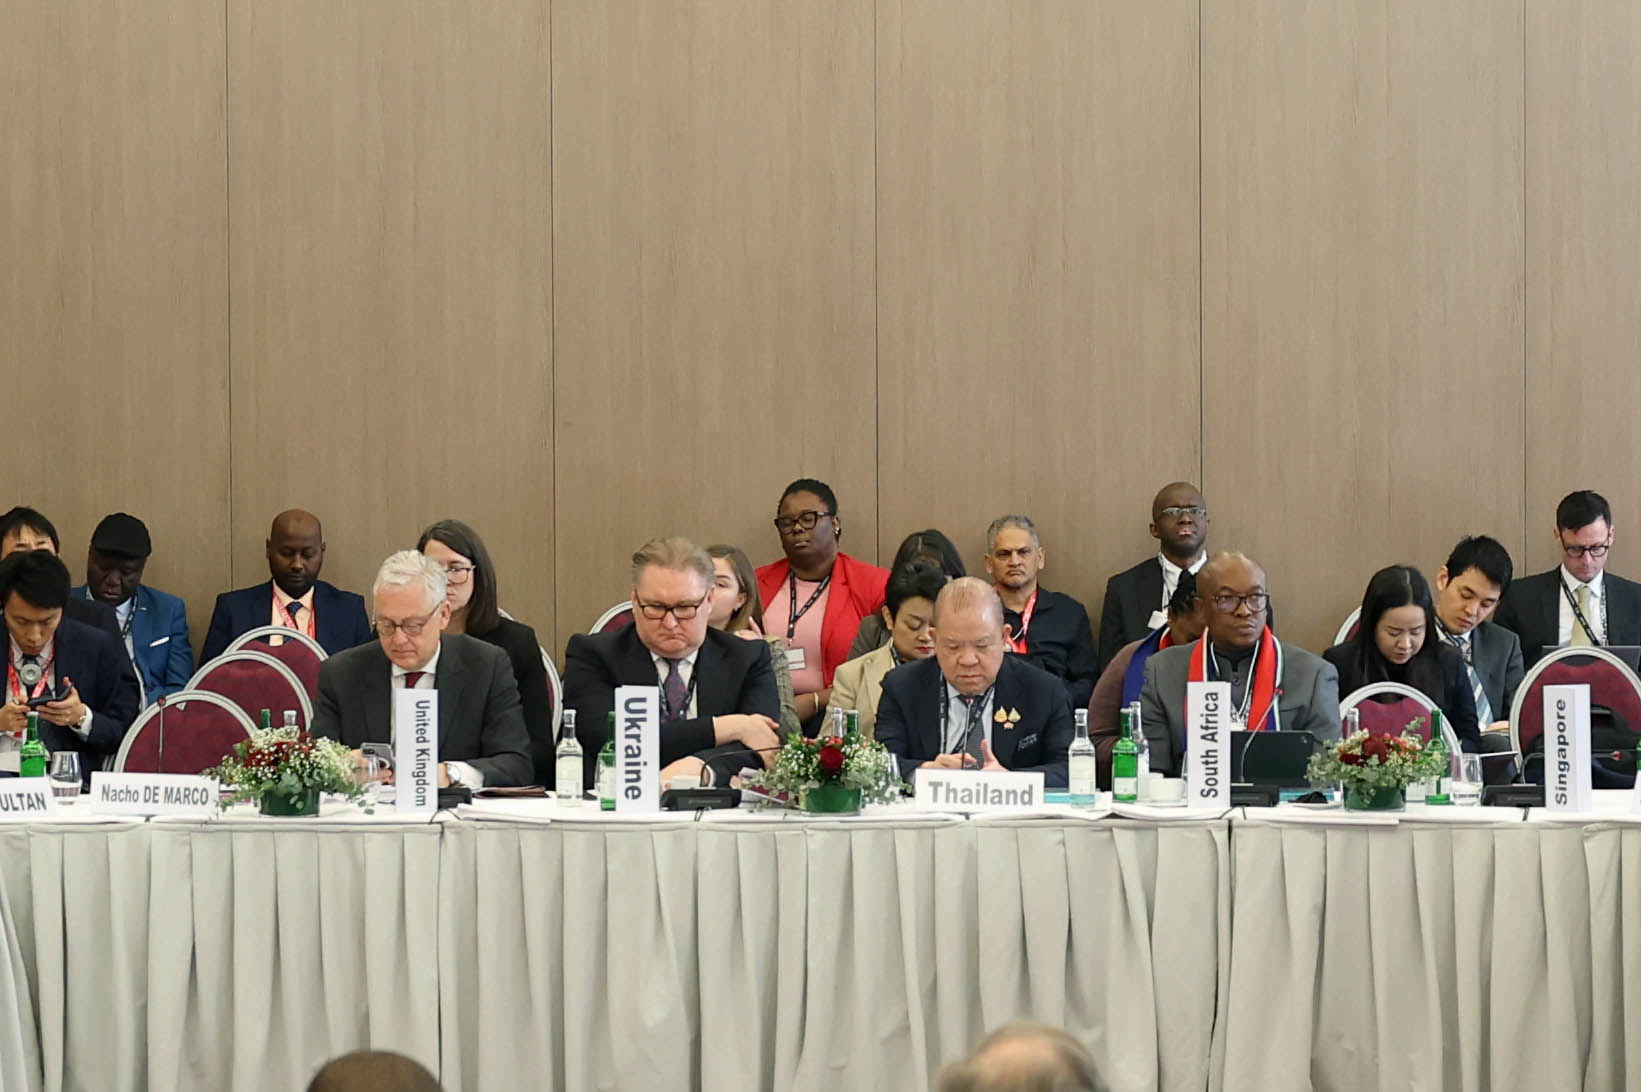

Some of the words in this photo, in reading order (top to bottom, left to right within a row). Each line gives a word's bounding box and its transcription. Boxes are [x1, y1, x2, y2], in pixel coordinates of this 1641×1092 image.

[415, 700, 431, 744] United
[1200, 691, 1219, 742] Africa
[624, 697, 648, 800] Ukraine
[1200, 746, 1219, 798] South
[1555, 698, 1571, 806] Singapore
[101, 784, 139, 803] Nacho
[143, 785, 160, 804] DE
[163, 786, 209, 806] MARCO
[411, 748, 431, 807] Kingdom
[928, 781, 1034, 806] Thailand
